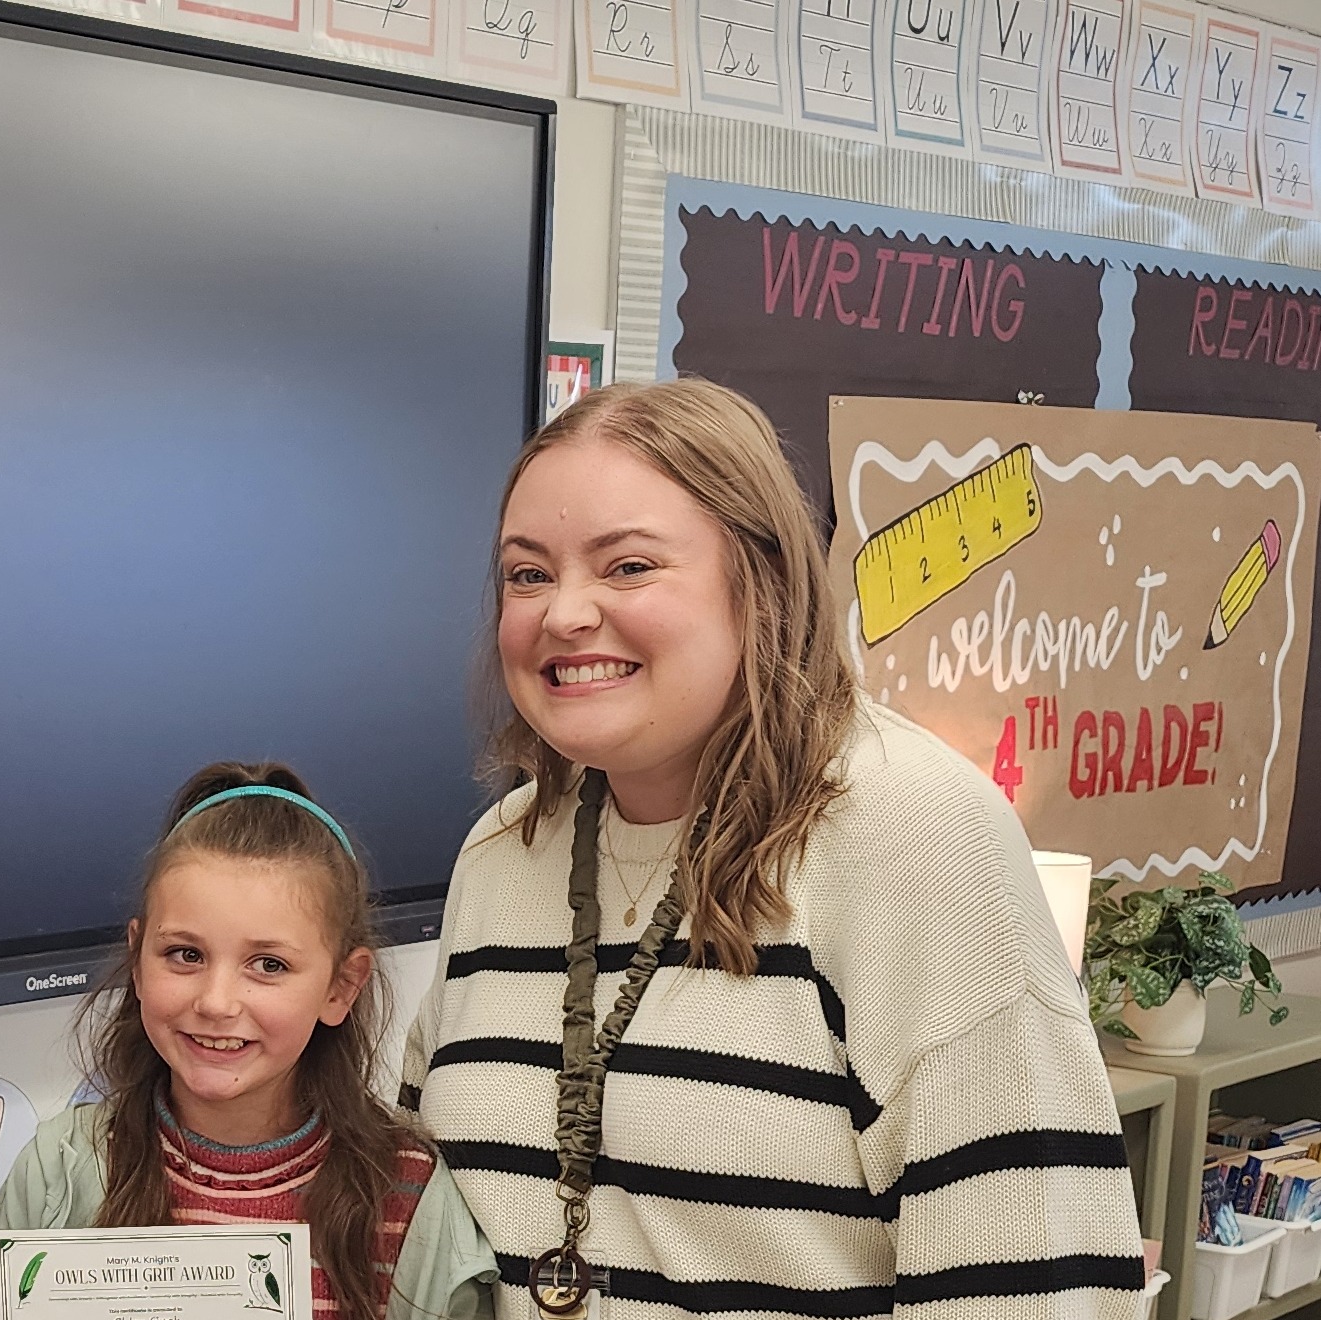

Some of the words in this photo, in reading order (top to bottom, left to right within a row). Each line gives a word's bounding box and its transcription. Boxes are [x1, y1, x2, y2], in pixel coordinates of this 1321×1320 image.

[762, 226, 1026, 343] WRITING
[919, 556, 931, 584] 2
[958, 535, 970, 564] 3
[991, 515, 1003, 538] 4
[1025, 491, 1037, 517] 5
[927, 569, 1129, 693] welcome
[1135, 564, 1183, 681] to
[1068, 700, 1223, 800] GRADE!
[26, 973, 88, 991] OneScreen
[55, 1269, 97, 1285] OWLS
[101, 1268, 139, 1283] WITH
[142, 1267, 176, 1282] GRIT
[180, 1265, 235, 1281] AWARD
[106, 1257, 130, 1266] Mary
[131, 1256, 142, 1264] M.
[143, 1255, 180, 1266] Knight's
